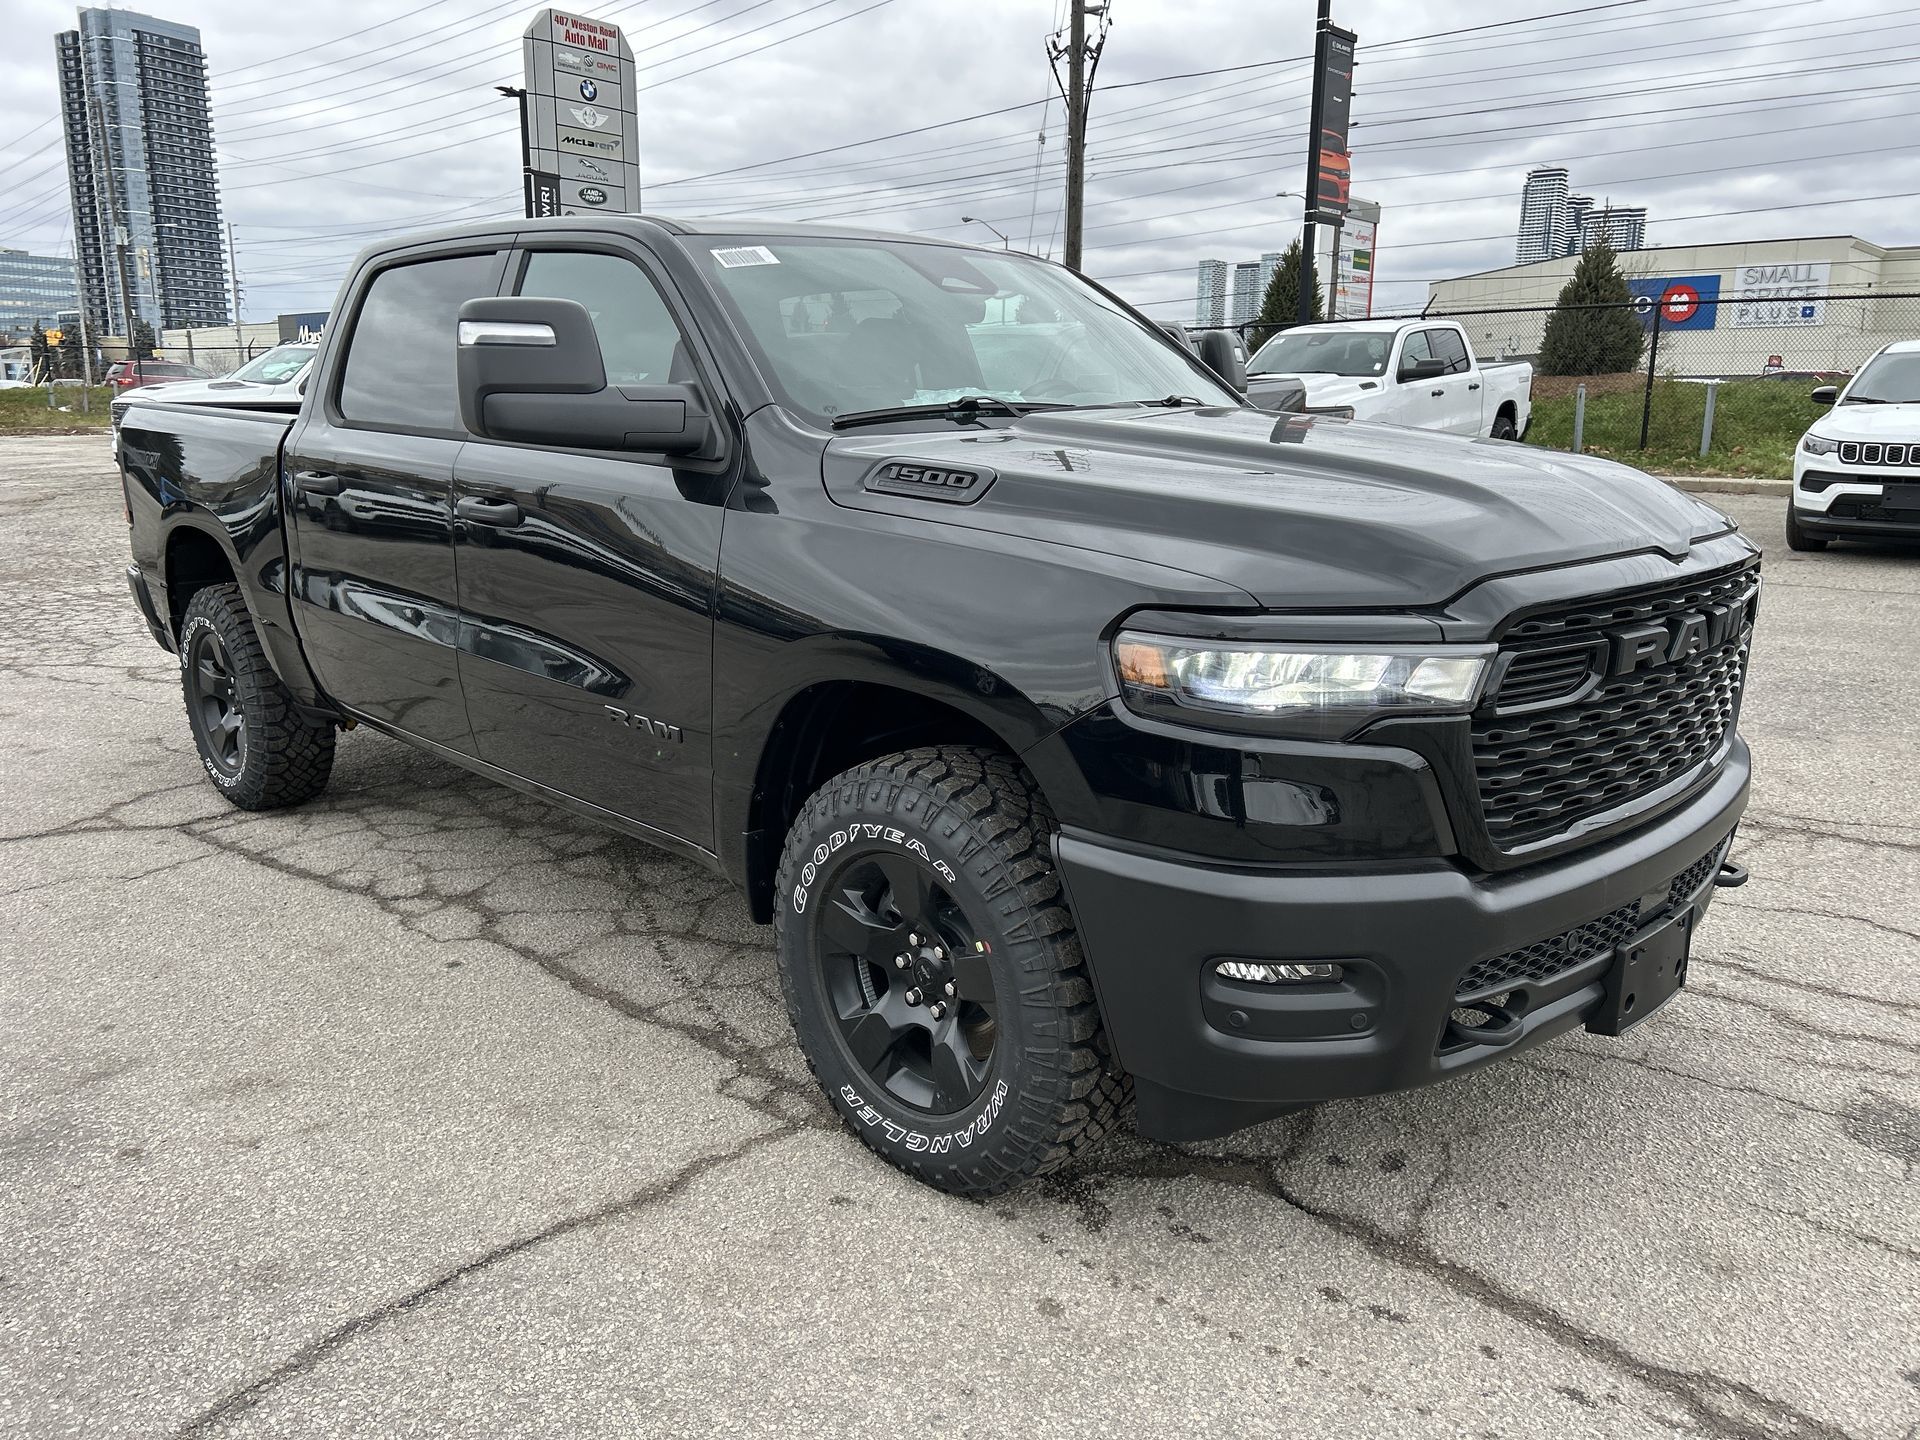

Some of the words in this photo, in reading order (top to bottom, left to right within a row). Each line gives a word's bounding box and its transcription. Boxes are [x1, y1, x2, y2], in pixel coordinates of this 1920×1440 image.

[554, 14, 569, 26] 407
[571, 18, 598, 34] Weston
[599, 26, 617, 39] Road
[564, 29, 585, 46] Auto
[588, 34, 608, 51] Mall
[596, 62, 617, 72] GMC
[561, 136, 615, 151] McLaren
[575, 173, 609, 182] JAGUAR
[583, 188, 599, 196] LAND
[585, 195, 604, 203] ROVER
[1743, 265, 1819, 285] SMALL
[1742, 286, 1817, 305] SPACE
[1739, 306, 1799, 320] PLUS
[888, 465, 974, 488] 1500
[182, 616, 226, 669] GOODYEAR
[1615, 600, 1742, 676] RAM
[604, 704, 684, 743] RAM
[793, 823, 957, 914] GOODYEAR
[840, 1079, 1009, 1154] WRANGLER
